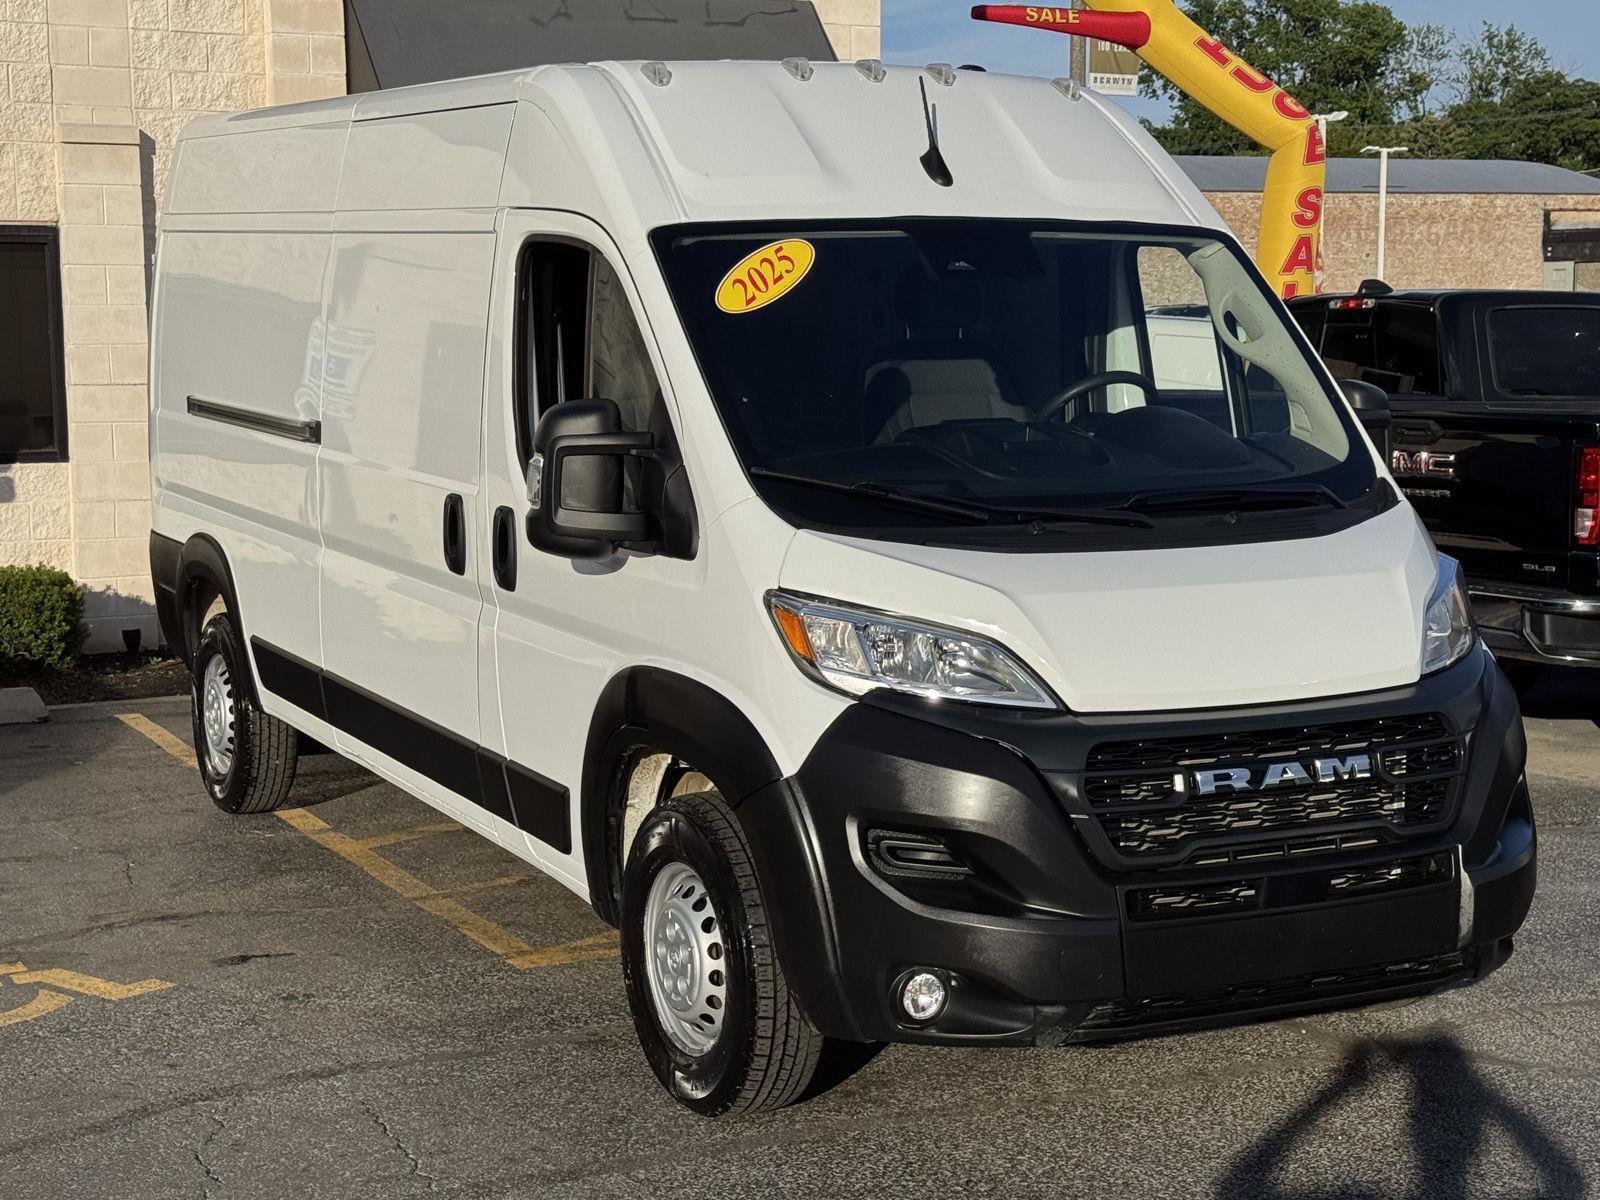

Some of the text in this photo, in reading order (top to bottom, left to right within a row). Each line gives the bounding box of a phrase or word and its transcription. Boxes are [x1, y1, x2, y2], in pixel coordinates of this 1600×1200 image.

[1025, 7, 1080, 24] SALE
[1093, 76, 1133, 85] BERWYN
[1193, 35, 1326, 166] HUGE
[732, 245, 795, 306] 2025
[1195, 754, 1372, 795] RAM
